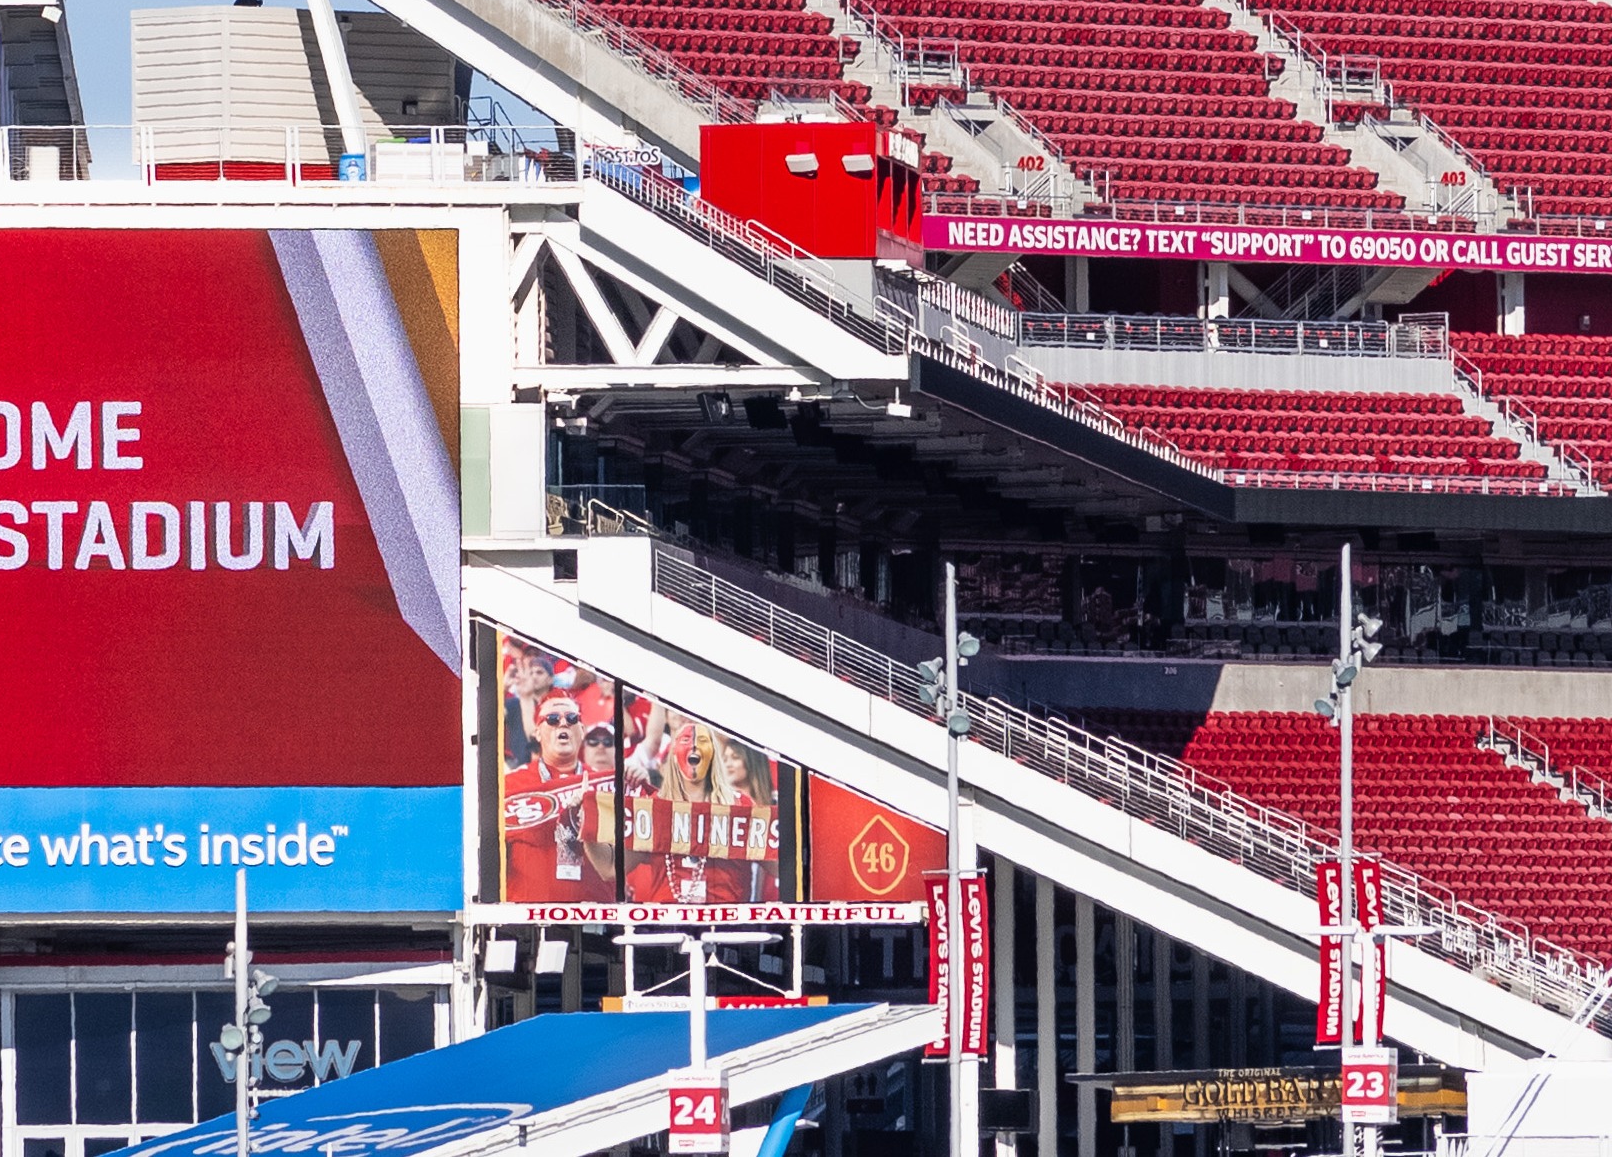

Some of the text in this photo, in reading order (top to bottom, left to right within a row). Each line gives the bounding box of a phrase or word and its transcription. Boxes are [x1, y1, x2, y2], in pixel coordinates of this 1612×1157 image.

[1017, 155, 1045, 172] 402
[1440, 171, 1466, 187] 403
[948, 222, 1005, 246] NEED
[1007, 224, 1142, 251] ASSISTANCE?
[1145, 230, 1197, 254] TEXT
[1200, 231, 1315, 258] "SUPPORT"
[1320, 237, 1347, 260] TO
[1349, 238, 1416, 262] 69050
[1419, 239, 1450, 263] OR
[1452, 241, 1503, 265] CALL
[1506, 242, 1570, 267] GUEST
[40, 824, 188, 868] what's
[527, 906, 905, 922] HOME OF THE FAITHFUL
[968, 884, 984, 1049] Levi's STADIUM
[1325, 869, 1341, 1036] Levis STADIUM
[209, 1040, 362, 1083] view
[1218, 1067, 1281, 1078] THE ORIGINAL
[1183, 1079, 1258, 1106] GOLD
[1347, 1071, 1385, 1099] 23
[674, 1095, 717, 1125] 24
